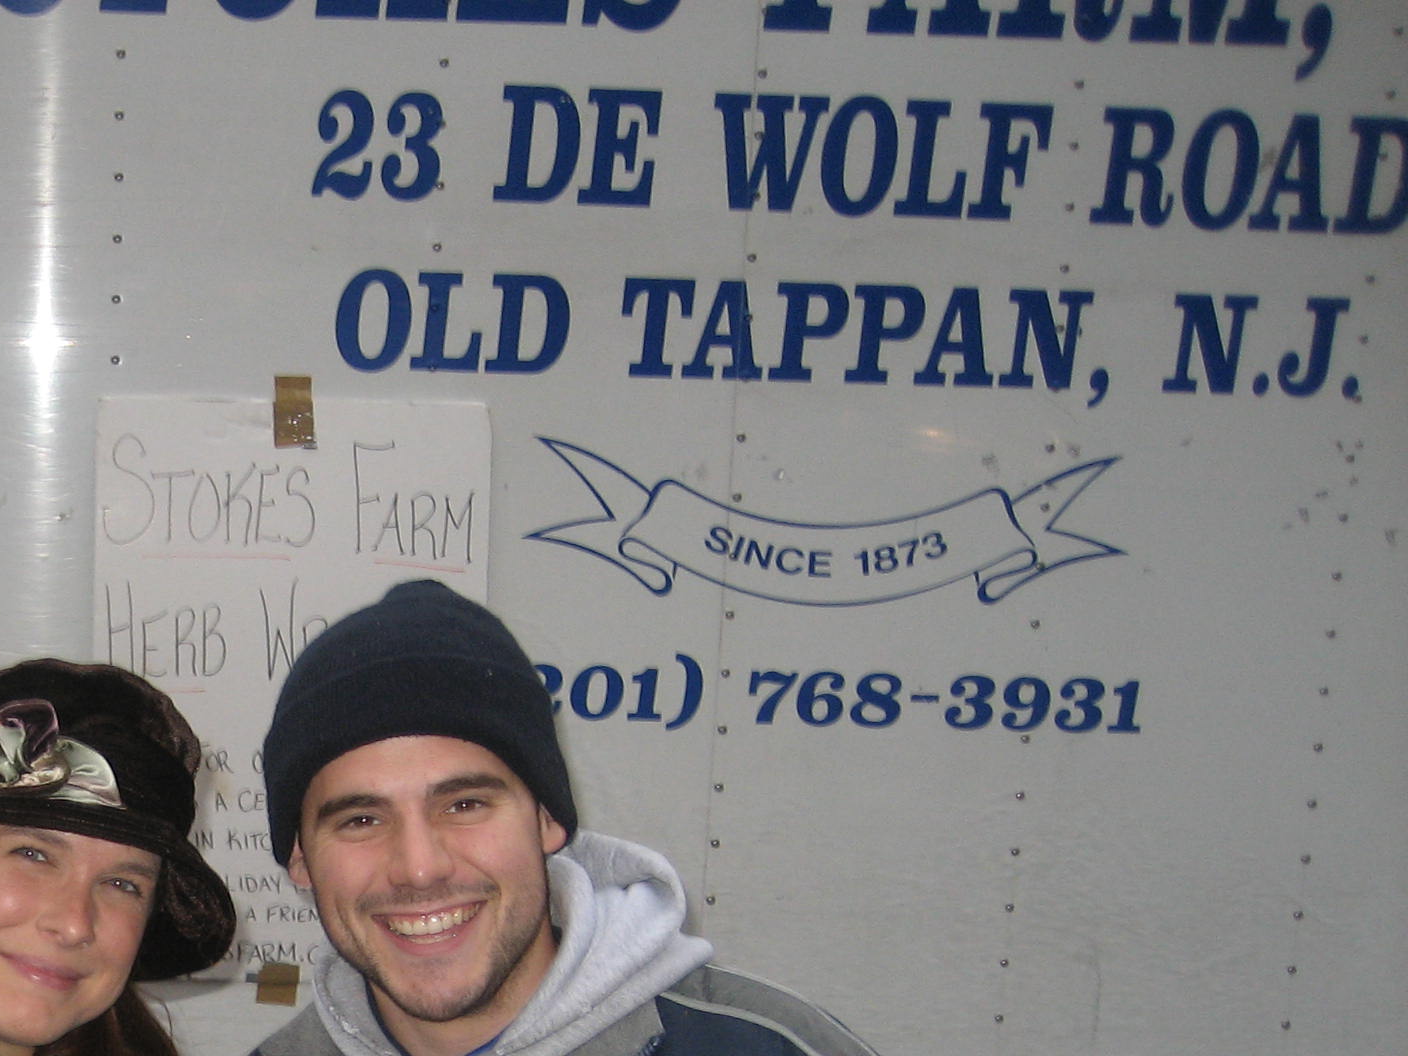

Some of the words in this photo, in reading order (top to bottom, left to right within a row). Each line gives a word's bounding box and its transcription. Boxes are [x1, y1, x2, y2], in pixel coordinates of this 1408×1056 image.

[312, 89, 444, 201] 23
[493, 85, 662, 207] DE
[715, 92, 1054, 221] WOLF
[1090, 106, 1408, 235] ROAD
[336, 269, 571, 373] OLD
[622, 277, 1110, 407] TAPPAN,
[1163, 294, 1360, 397] N.J.
[102, 432, 316, 548] STOKES
[353, 441, 476, 564] FARM
[704, 526, 833, 579] SINCE
[854, 531, 948, 577] 1873
[106, 580, 227, 678] HERB
[748, 669, 1141, 734] 768-3931
[238, 789, 266, 813] CE
[227, 827, 272, 852] KITC
[224, 873, 282, 895] LIDAY
[267, 904, 320, 924] FRIEN
